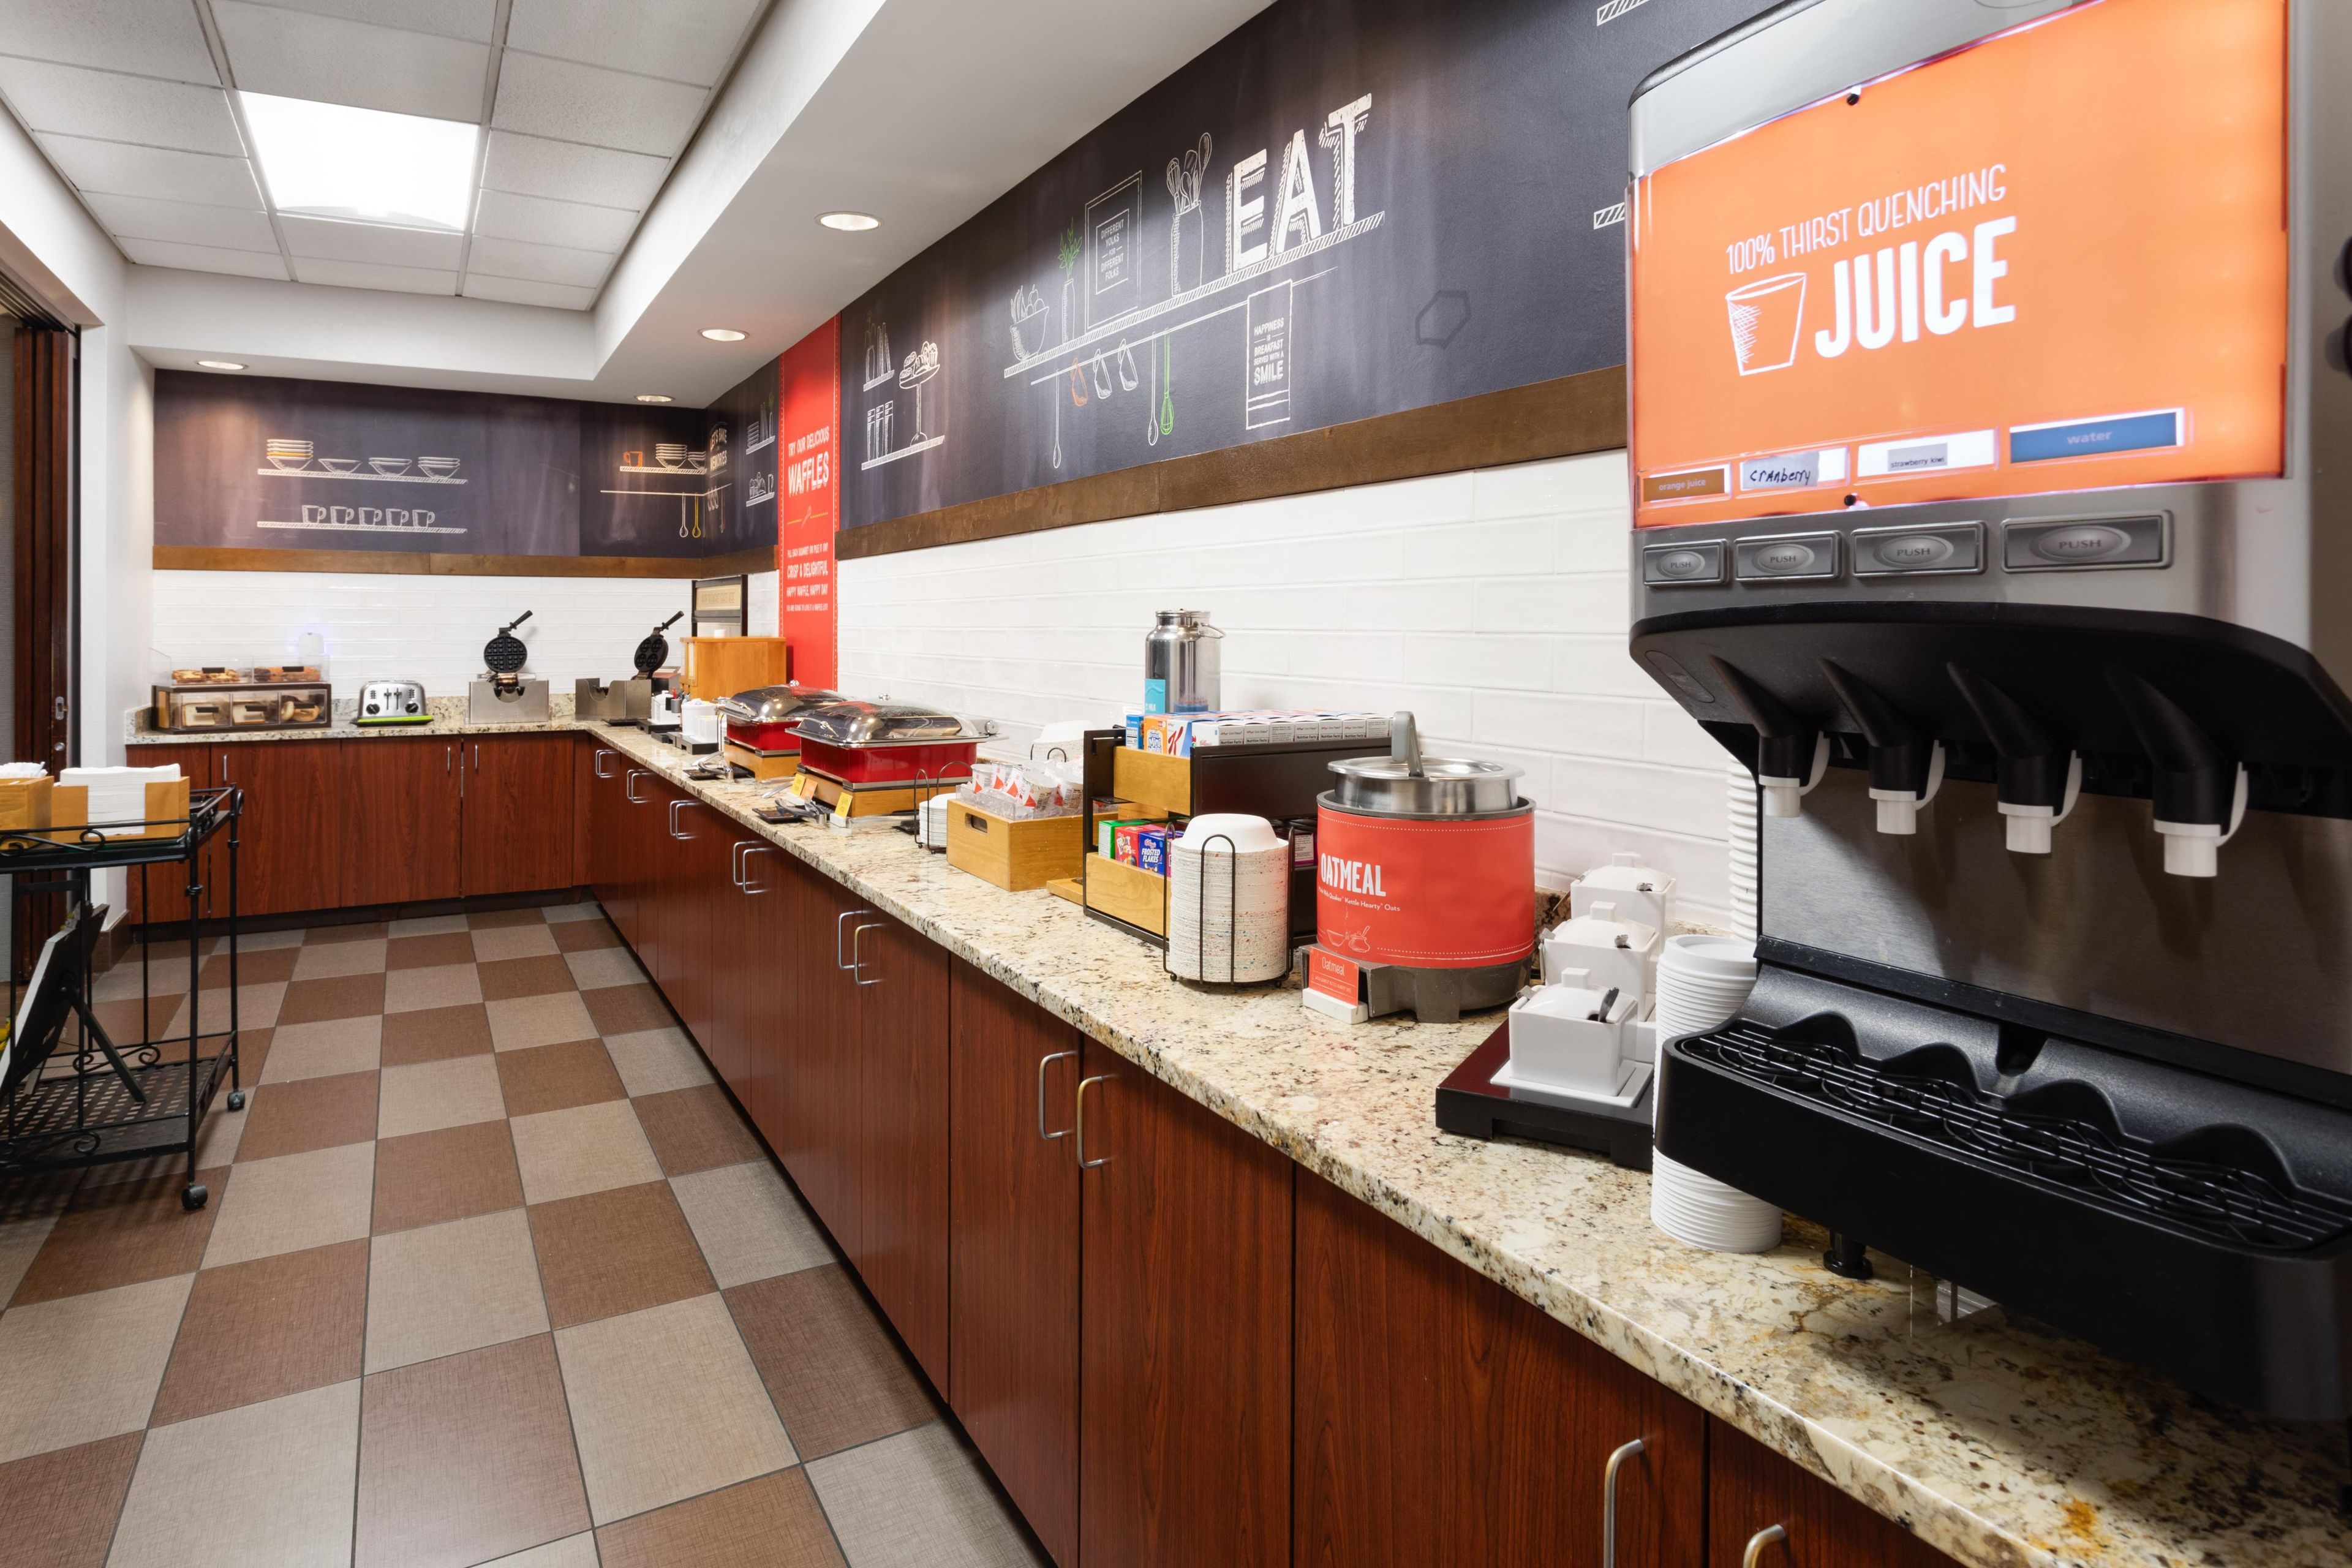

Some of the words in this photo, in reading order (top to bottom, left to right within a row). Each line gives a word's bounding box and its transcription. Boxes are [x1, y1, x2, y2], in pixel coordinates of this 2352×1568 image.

[1226, 93, 1372, 274] EAT
[1725, 233, 1775, 274] 100%
[1779, 207, 1852, 259] THIRST
[1858, 164, 2007, 237] QUENCHING
[1101, 219, 1124, 239] DIFFERENT
[1106, 233, 1120, 247] YOLKS
[1101, 253, 1124, 273] DIFFERENT
[1105, 267, 1119, 281] FOLKS
[1815, 216, 2016, 358] JUICE
[1254, 317, 1284, 336] HAPPINESS
[1254, 339, 1284, 356] BREAKFAST
[1253, 355, 1269, 366] SERVED
[1269, 352, 1280, 361] WITH
[1253, 360, 1284, 386] SMILE
[797, 436, 805, 454] OUR
[807, 426, 829, 450] DELICIOUS
[2067, 431, 2113, 445] water
[1891, 458, 1929, 469] strawberry
[1931, 456, 1945, 464] kiwi
[788, 451, 829, 497] WAFFLES
[1659, 481, 1685, 492] orange
[1687, 478, 1706, 489] juice
[1897, 548, 1931, 557] PUSH
[2059, 540, 2101, 549] PUSH
[787, 564, 799, 579] CRISP
[799, 563, 803, 578] &
[803, 560, 828, 578] DELIGHTFUL
[786, 586, 797, 597] HAPPY
[810, 584, 821, 597] HAPPY
[1168, 726, 1183, 755] K
[1321, 853, 1386, 897] OATMEAL
[1344, 897, 1360, 907] Kettle
[1322, 956, 1345, 977] Oatmeal
